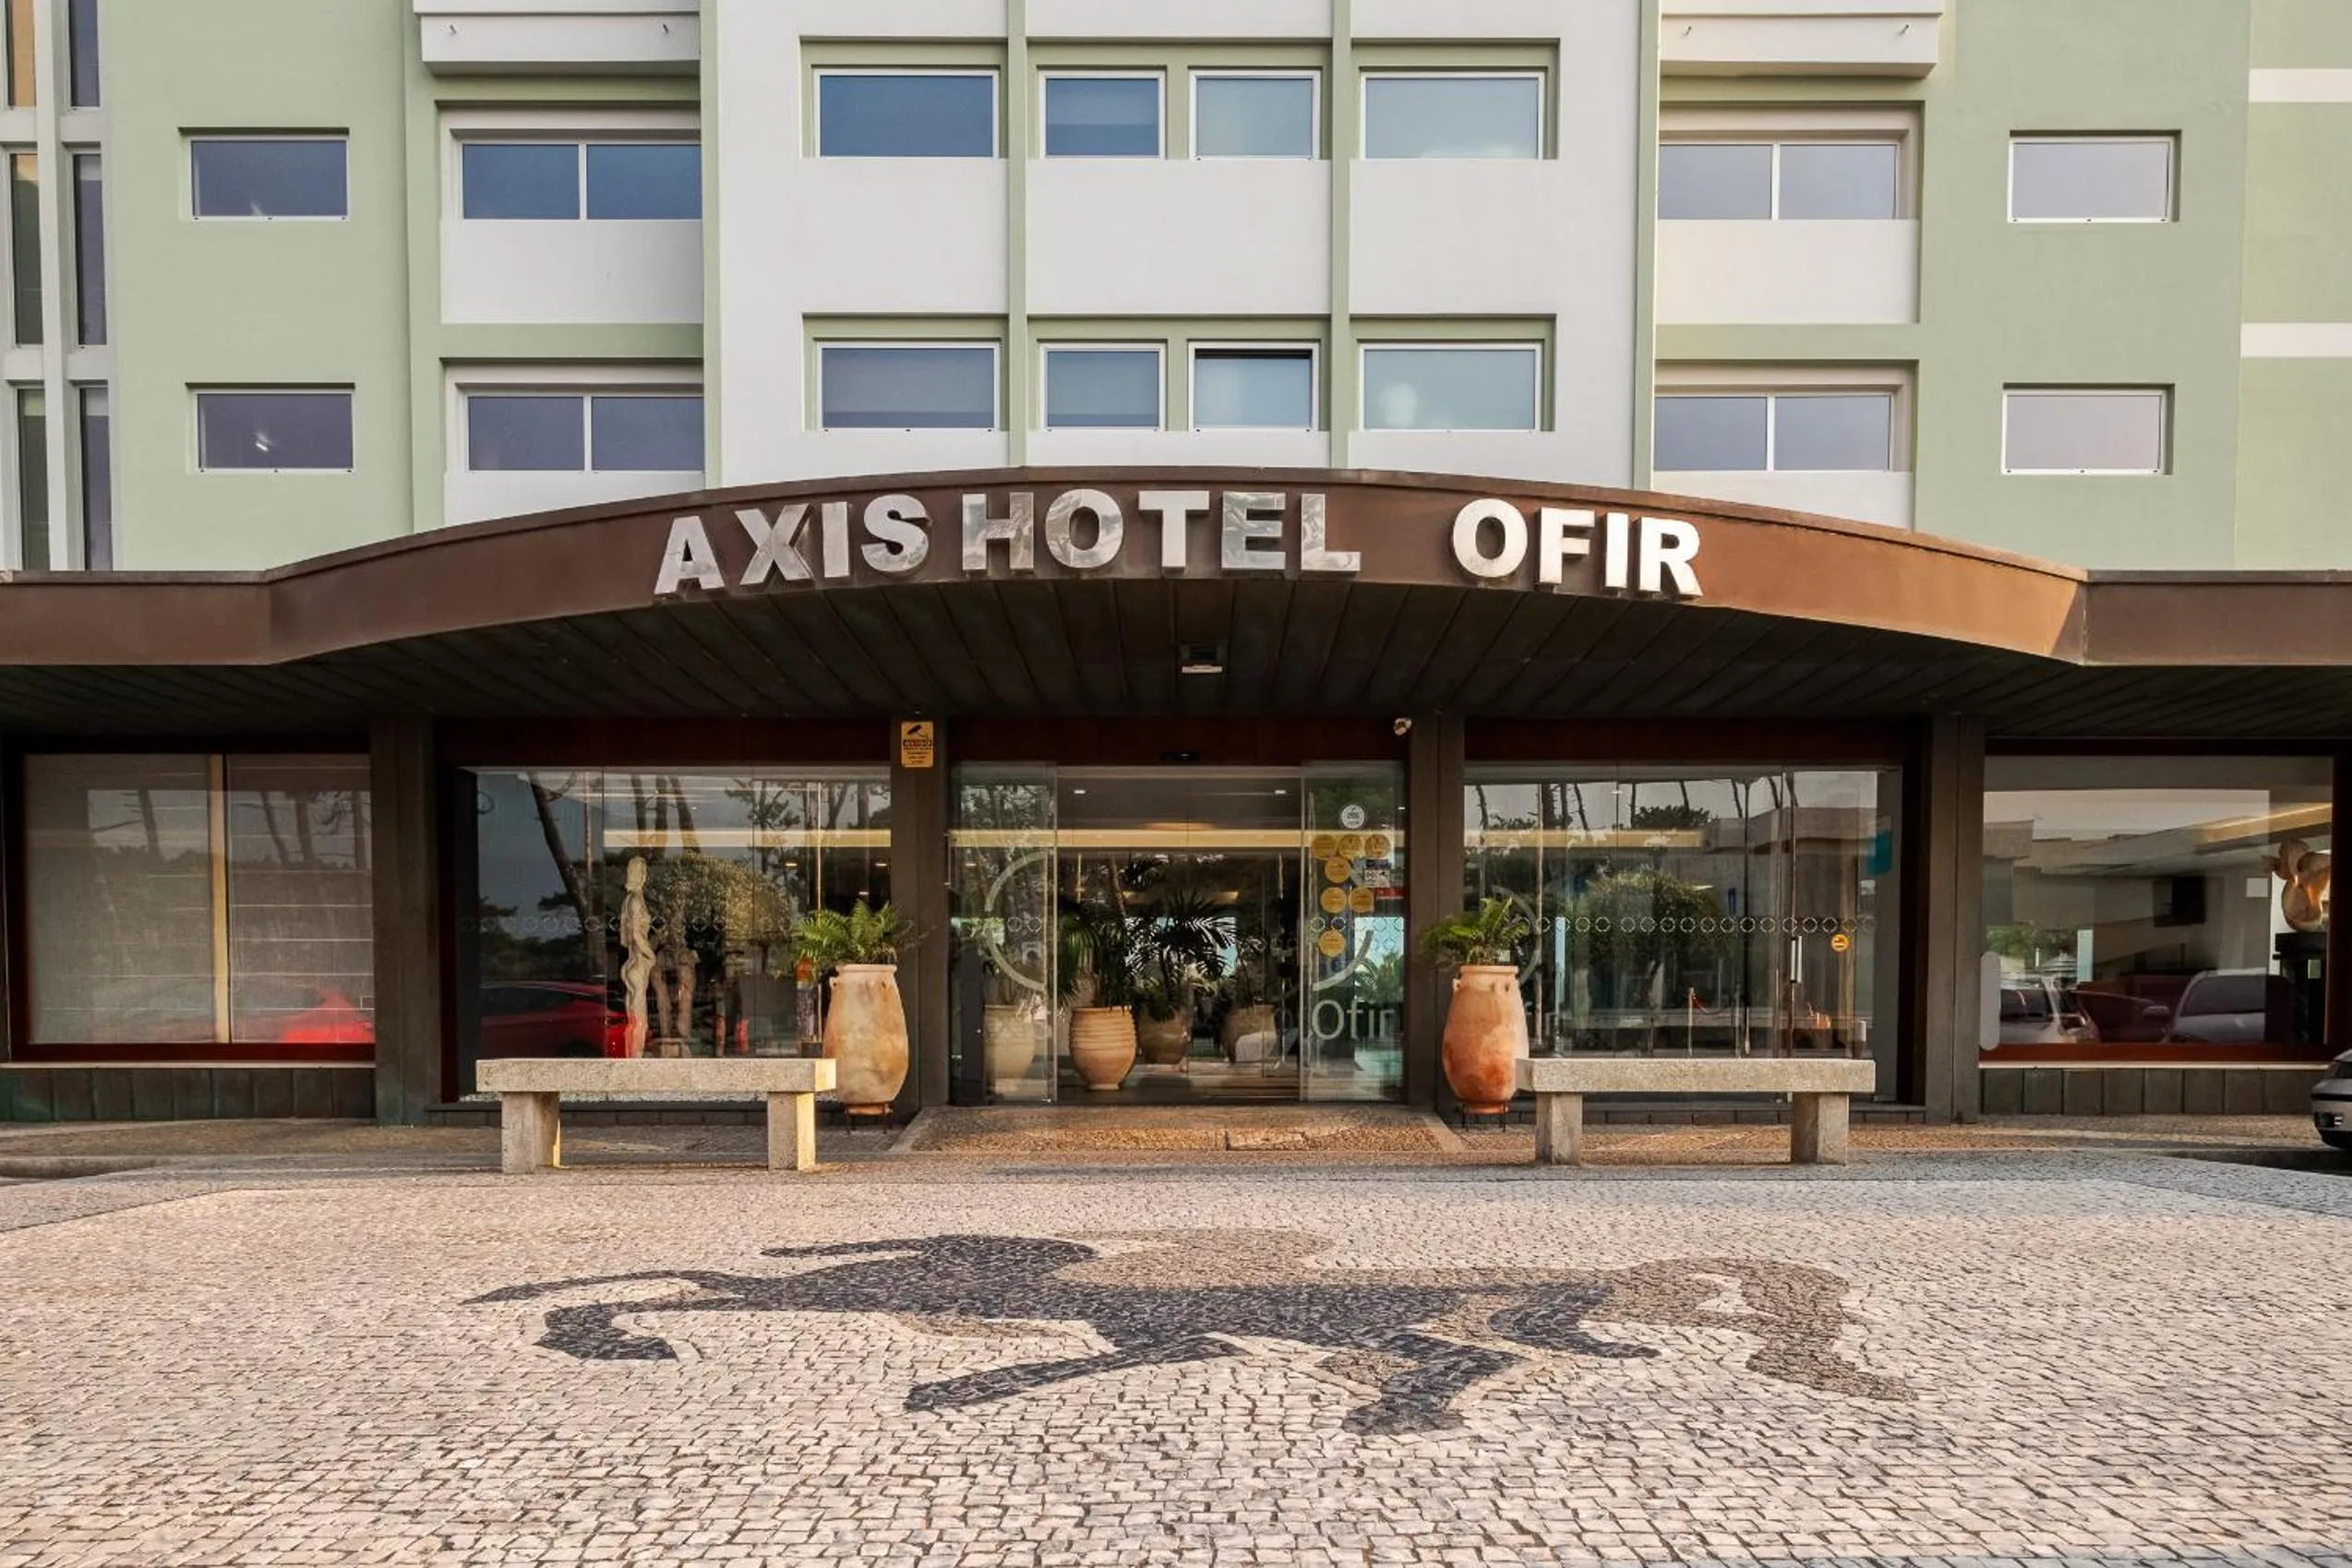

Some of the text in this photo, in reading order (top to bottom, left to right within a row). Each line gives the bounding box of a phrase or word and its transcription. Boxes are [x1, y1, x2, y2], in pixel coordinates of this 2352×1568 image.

[654, 488, 1703, 597] AXIS HOTEL OFIR
